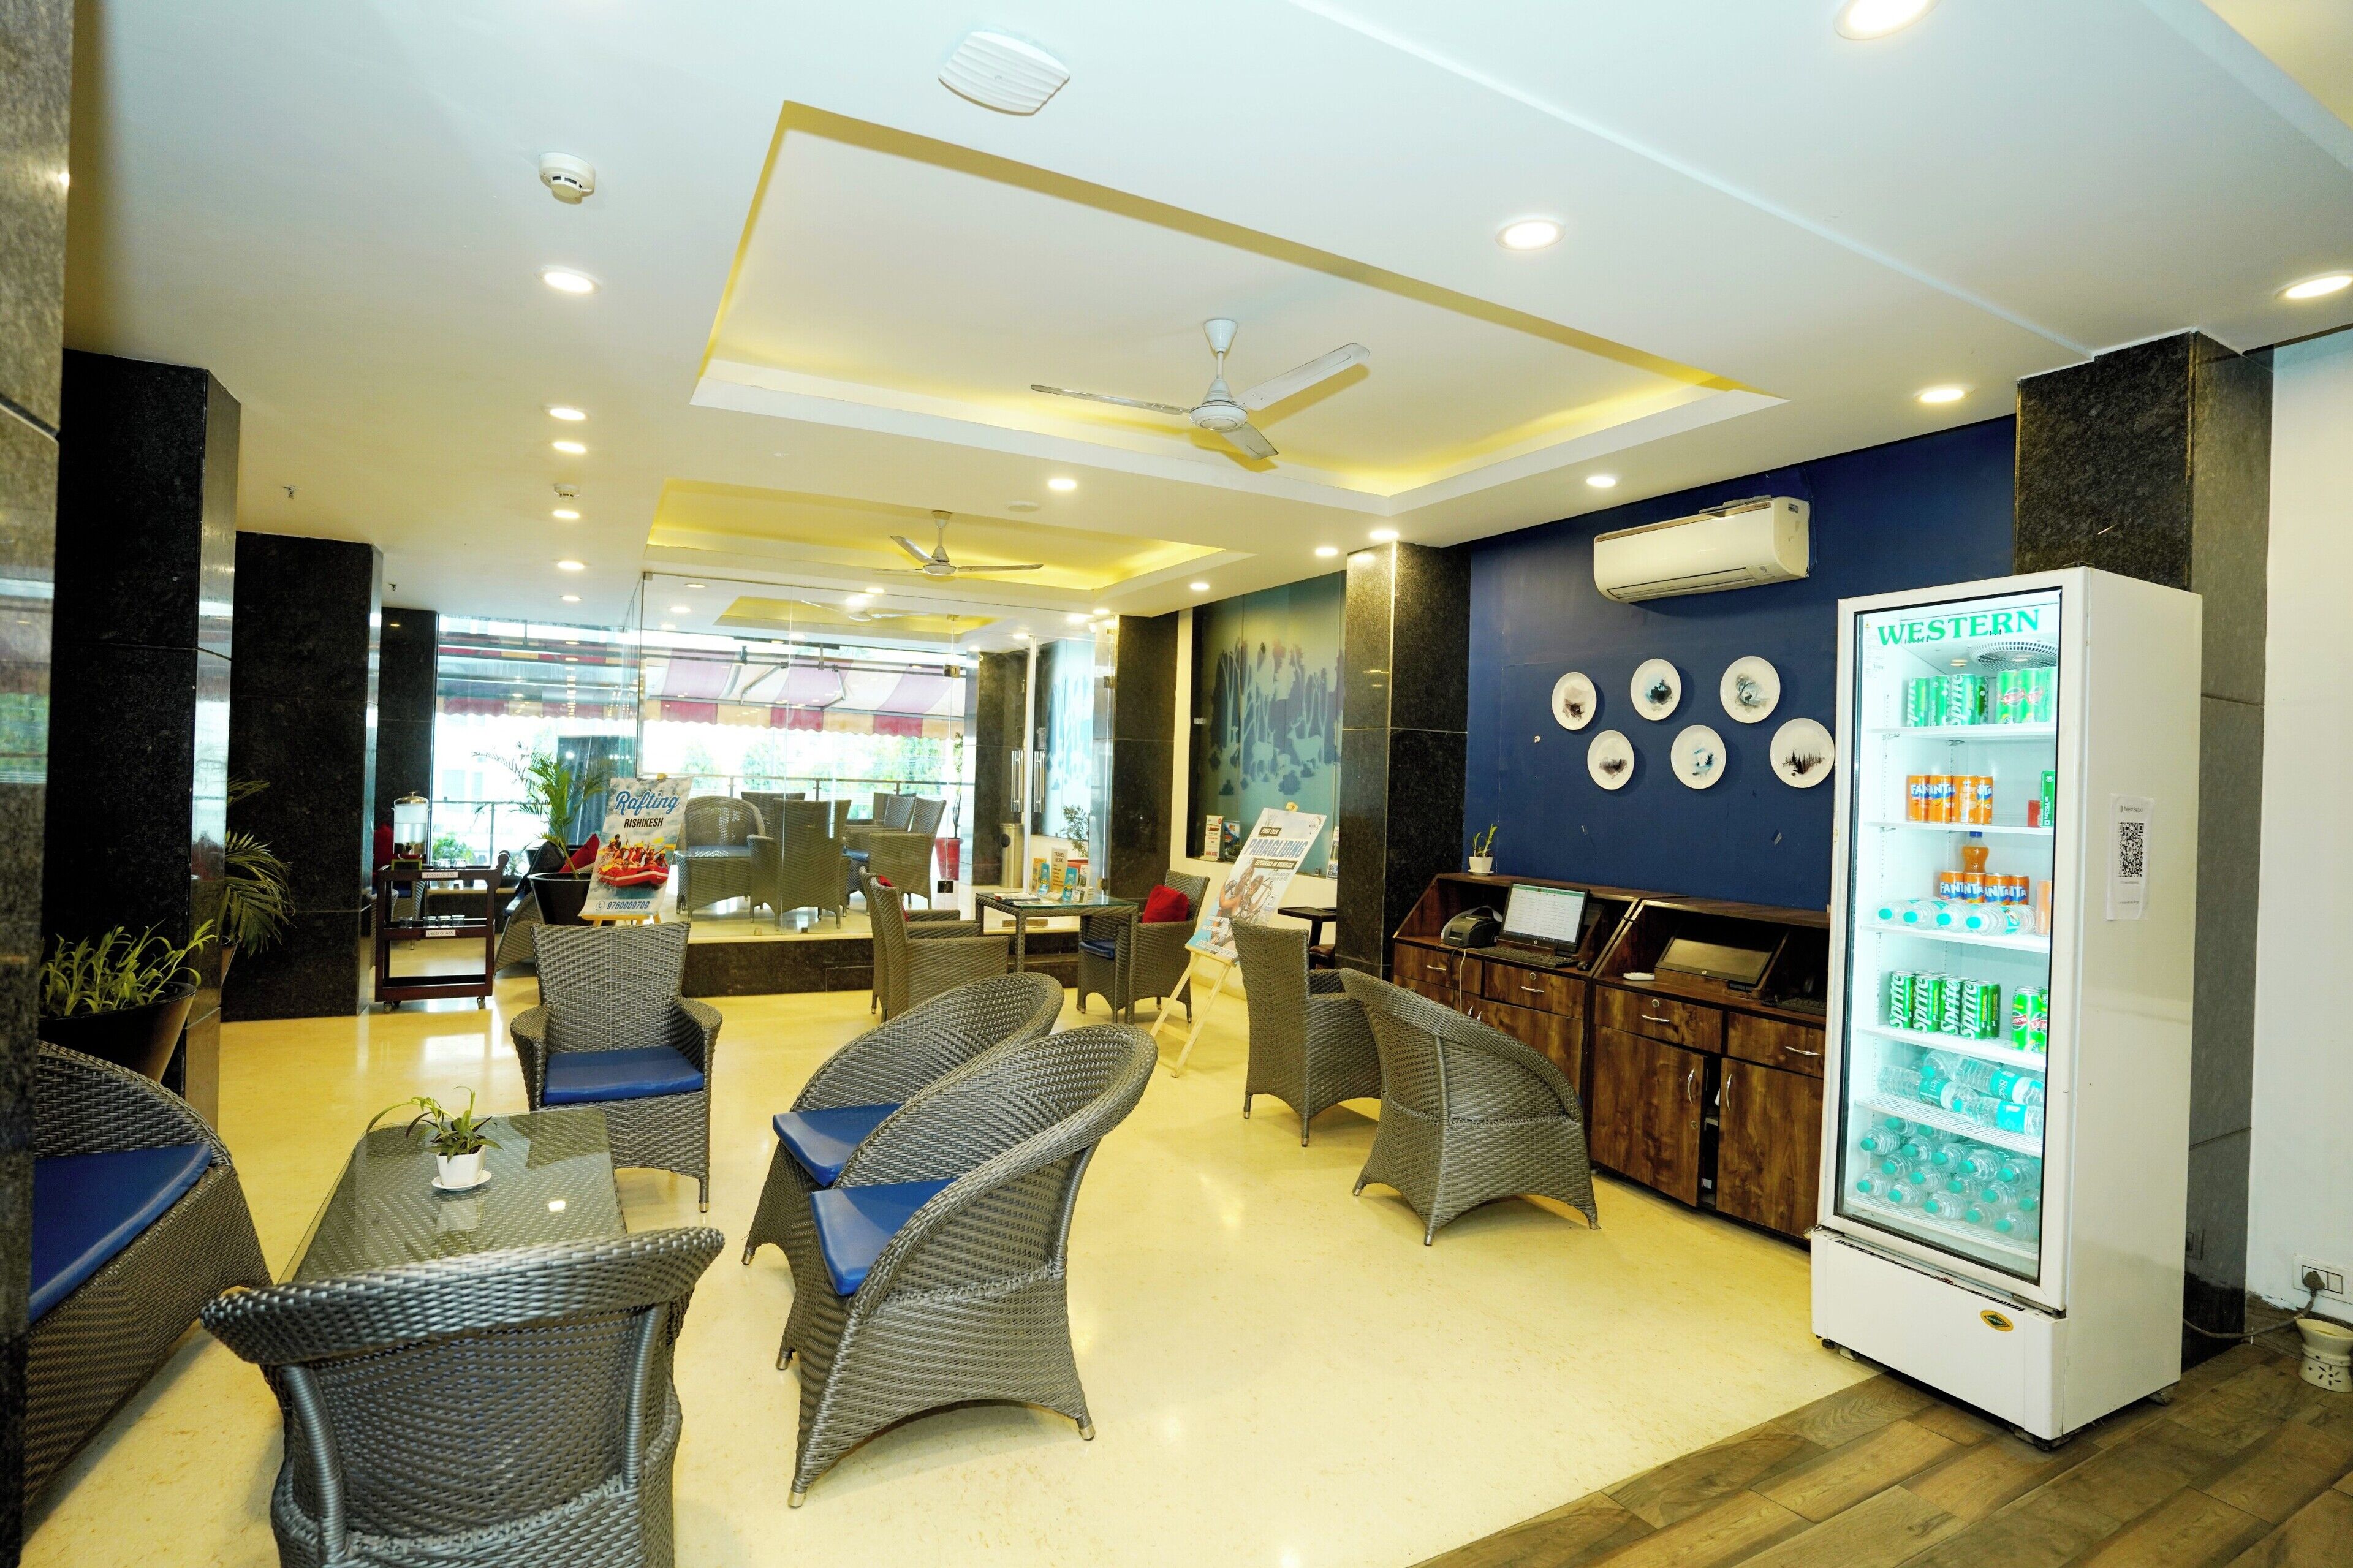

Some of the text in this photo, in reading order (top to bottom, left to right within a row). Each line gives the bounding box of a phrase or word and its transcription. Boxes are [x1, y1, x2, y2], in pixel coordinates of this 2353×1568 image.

[1877, 609, 2040, 646] WESTERN
[615, 790, 680, 816] Rafting
[624, 817, 663, 828] RISHIKESH
[1243, 839, 1308, 858] PARAGLIDING
[607, 901, 650, 909] 9760009709
[1889, 974, 1908, 1030] Sprite
[1913, 978, 1932, 1033] Sprite
[1941, 980, 1961, 1035] Sprite
[1961, 983, 1980, 1039] Sprite
